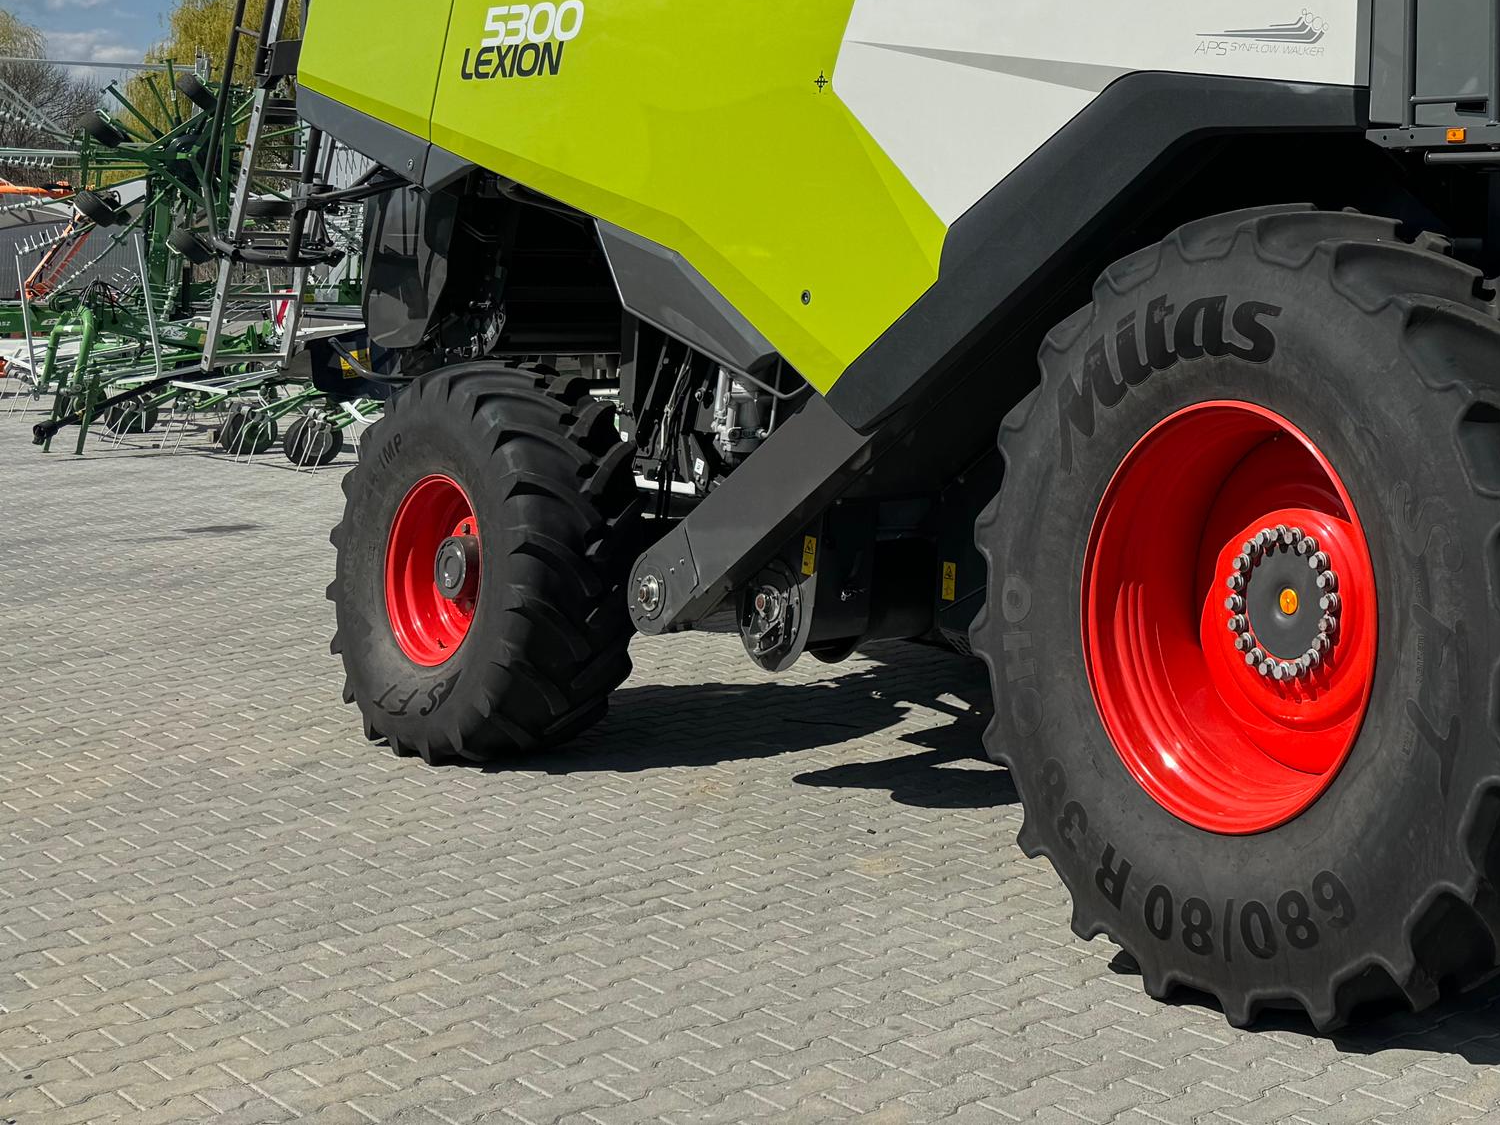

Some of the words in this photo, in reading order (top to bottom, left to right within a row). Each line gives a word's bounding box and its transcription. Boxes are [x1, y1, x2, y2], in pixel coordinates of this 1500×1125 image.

[480, 0, 584, 46] 5300
[461, 41, 564, 80] LEXION
[1194, 40, 1228, 56] APS
[1230, 42, 1280, 54] SYNFLOW
[1282, 44, 1325, 57] WALKER
[1057, 293, 1284, 475] Mitas
[377, 432, 404, 469] IMP
[1095, 840, 1144, 910] R
[1144, 870, 1357, 962] 680/80
